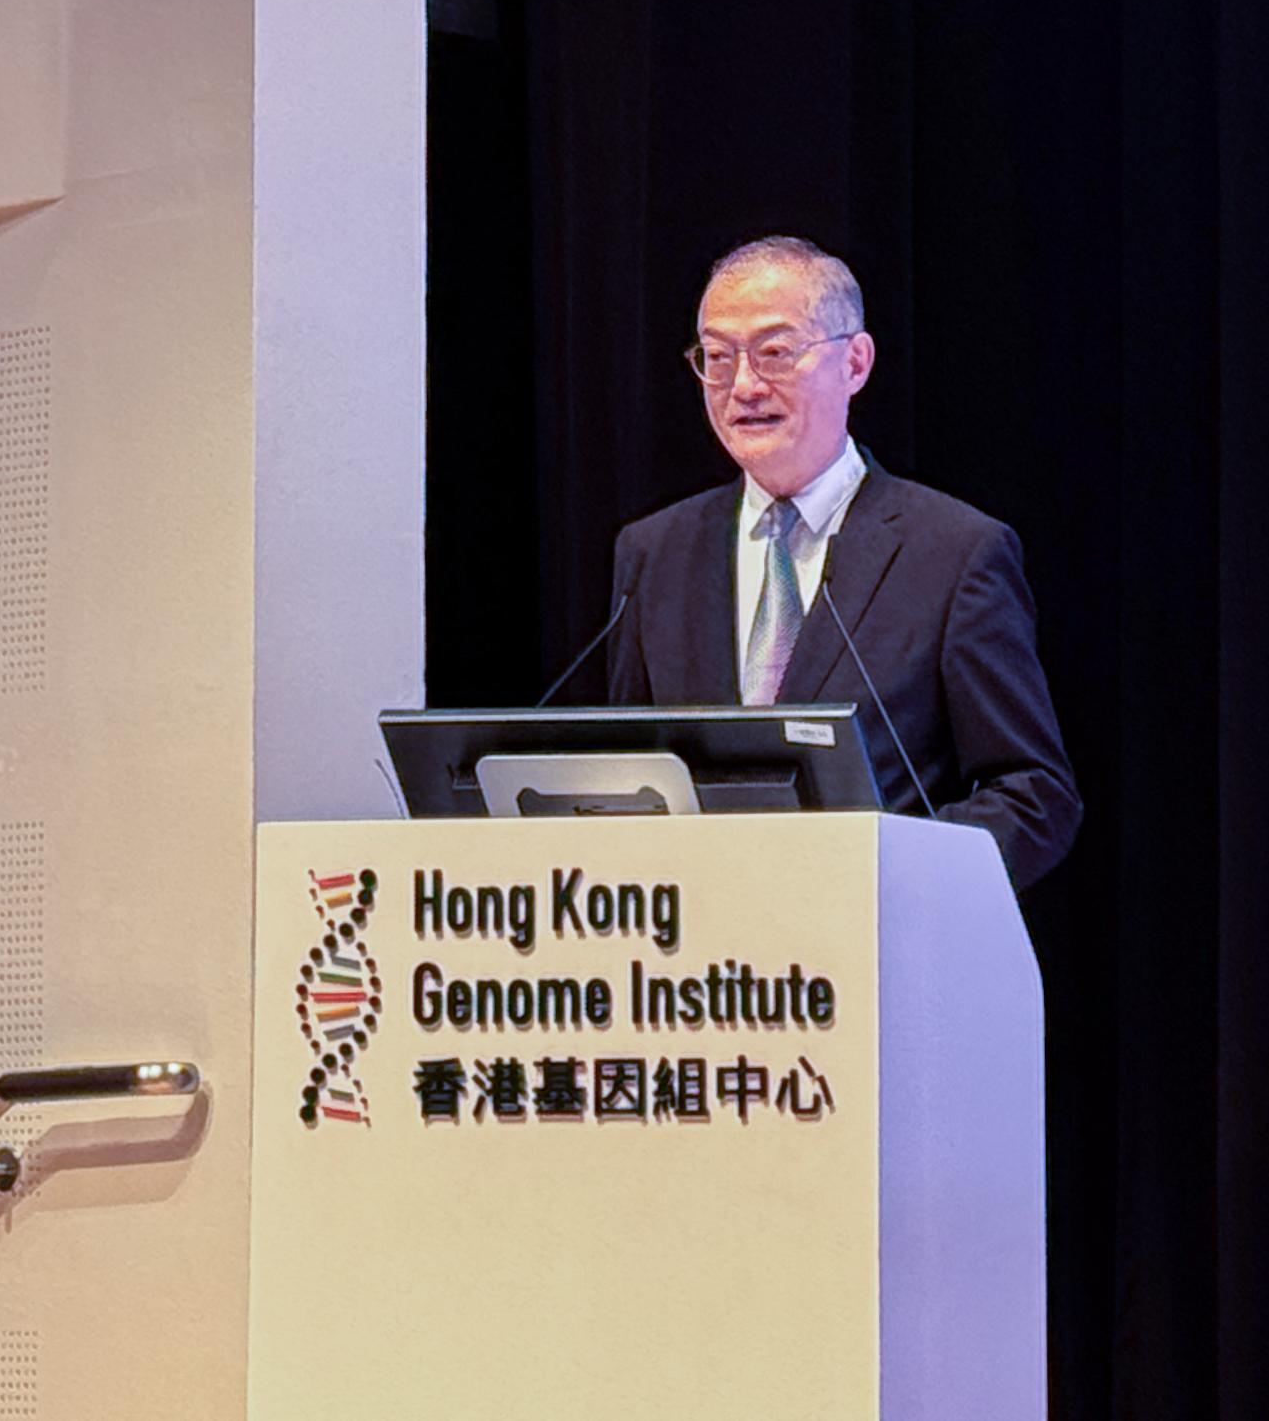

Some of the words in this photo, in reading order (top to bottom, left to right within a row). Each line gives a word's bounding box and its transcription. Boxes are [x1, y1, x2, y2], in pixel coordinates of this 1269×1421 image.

[413, 869, 535, 948] Hong
[551, 868, 681, 949] Kong
[412, 961, 613, 1028] Genome
[630, 958, 836, 1028] Institute
[412, 1055, 836, 1125] 香港基因組中心
